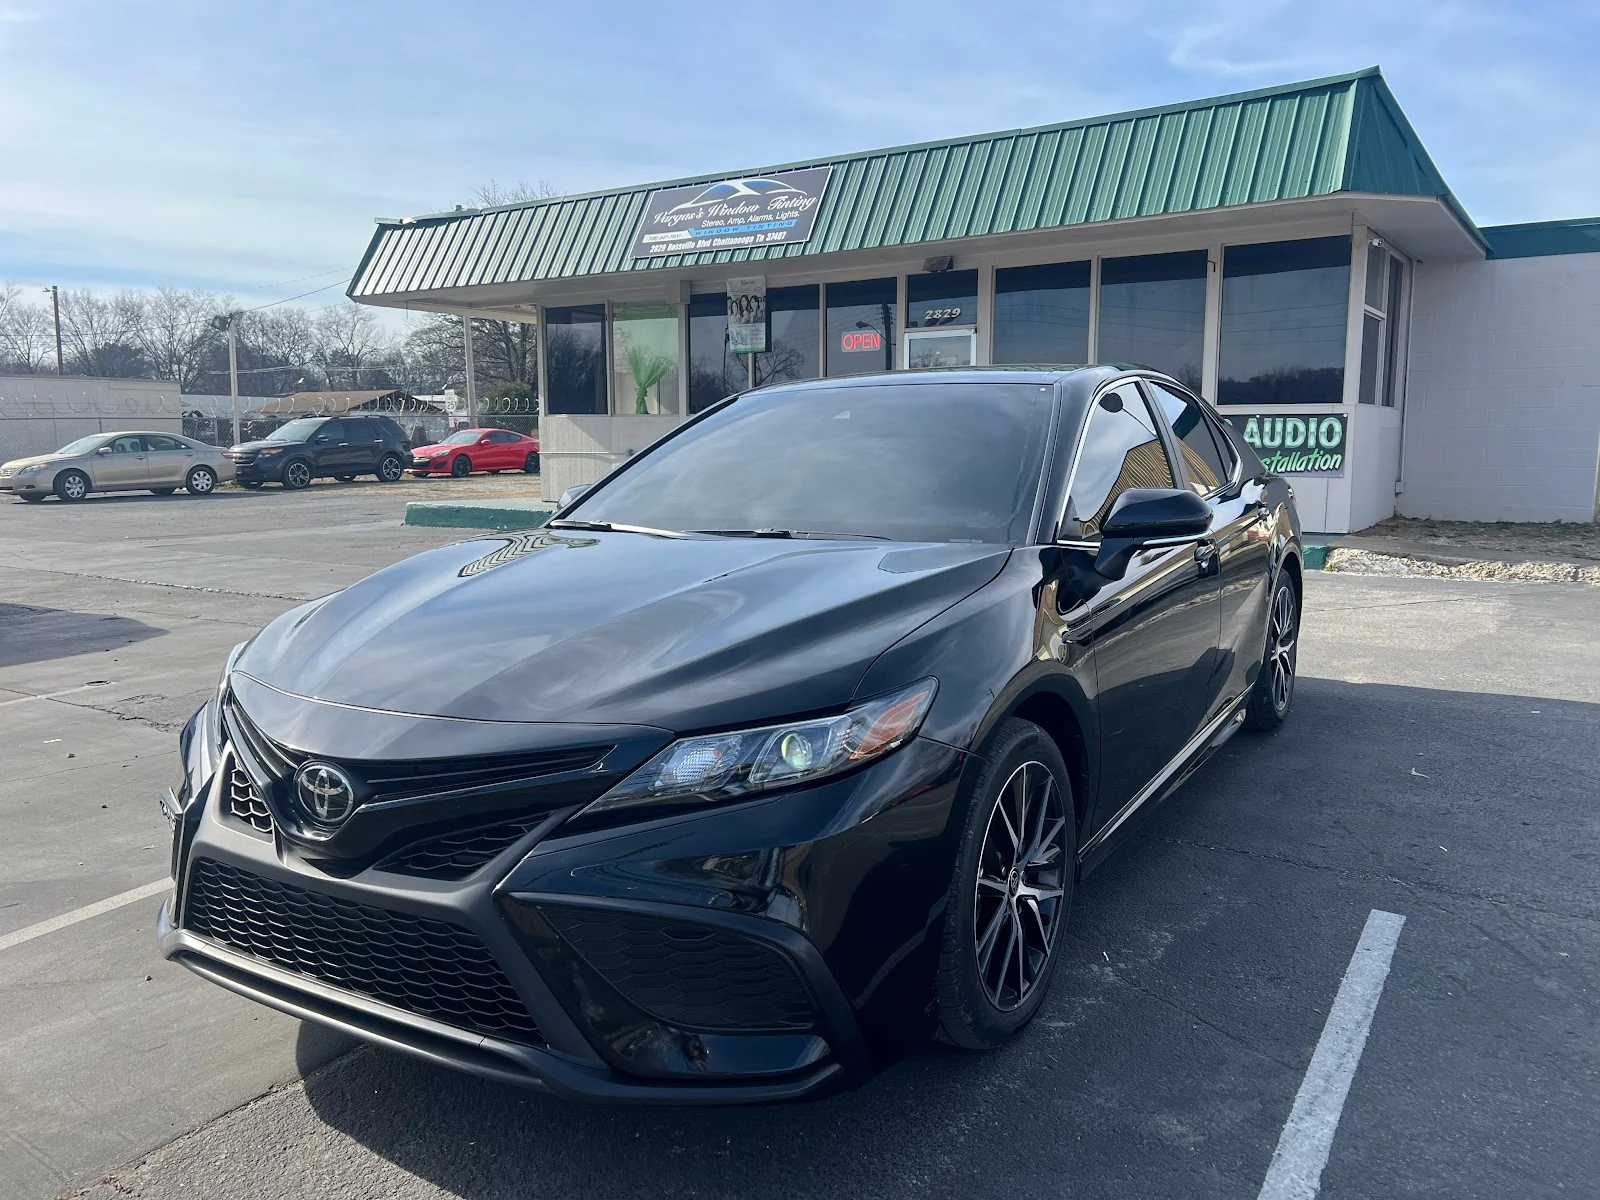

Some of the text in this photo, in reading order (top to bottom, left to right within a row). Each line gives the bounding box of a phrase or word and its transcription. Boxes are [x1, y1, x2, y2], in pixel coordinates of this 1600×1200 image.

[708, 201, 759, 217] Window
[767, 195, 816, 211] Tinting
[695, 220, 794, 236] WINDOW TINTING
[702, 220, 725, 228] Stereo,
[727, 216, 745, 225] Amp,
[667, 240, 695, 251] Rossville
[696, 238, 712, 249] Blvd
[712, 235, 754, 247] Chattanooga
[765, 230, 788, 242] 37407
[923, 307, 961, 320] 2829
[843, 332, 880, 350] OPEN
[1243, 417, 1342, 448] AUDIO
[1260, 448, 1342, 473] stallation
